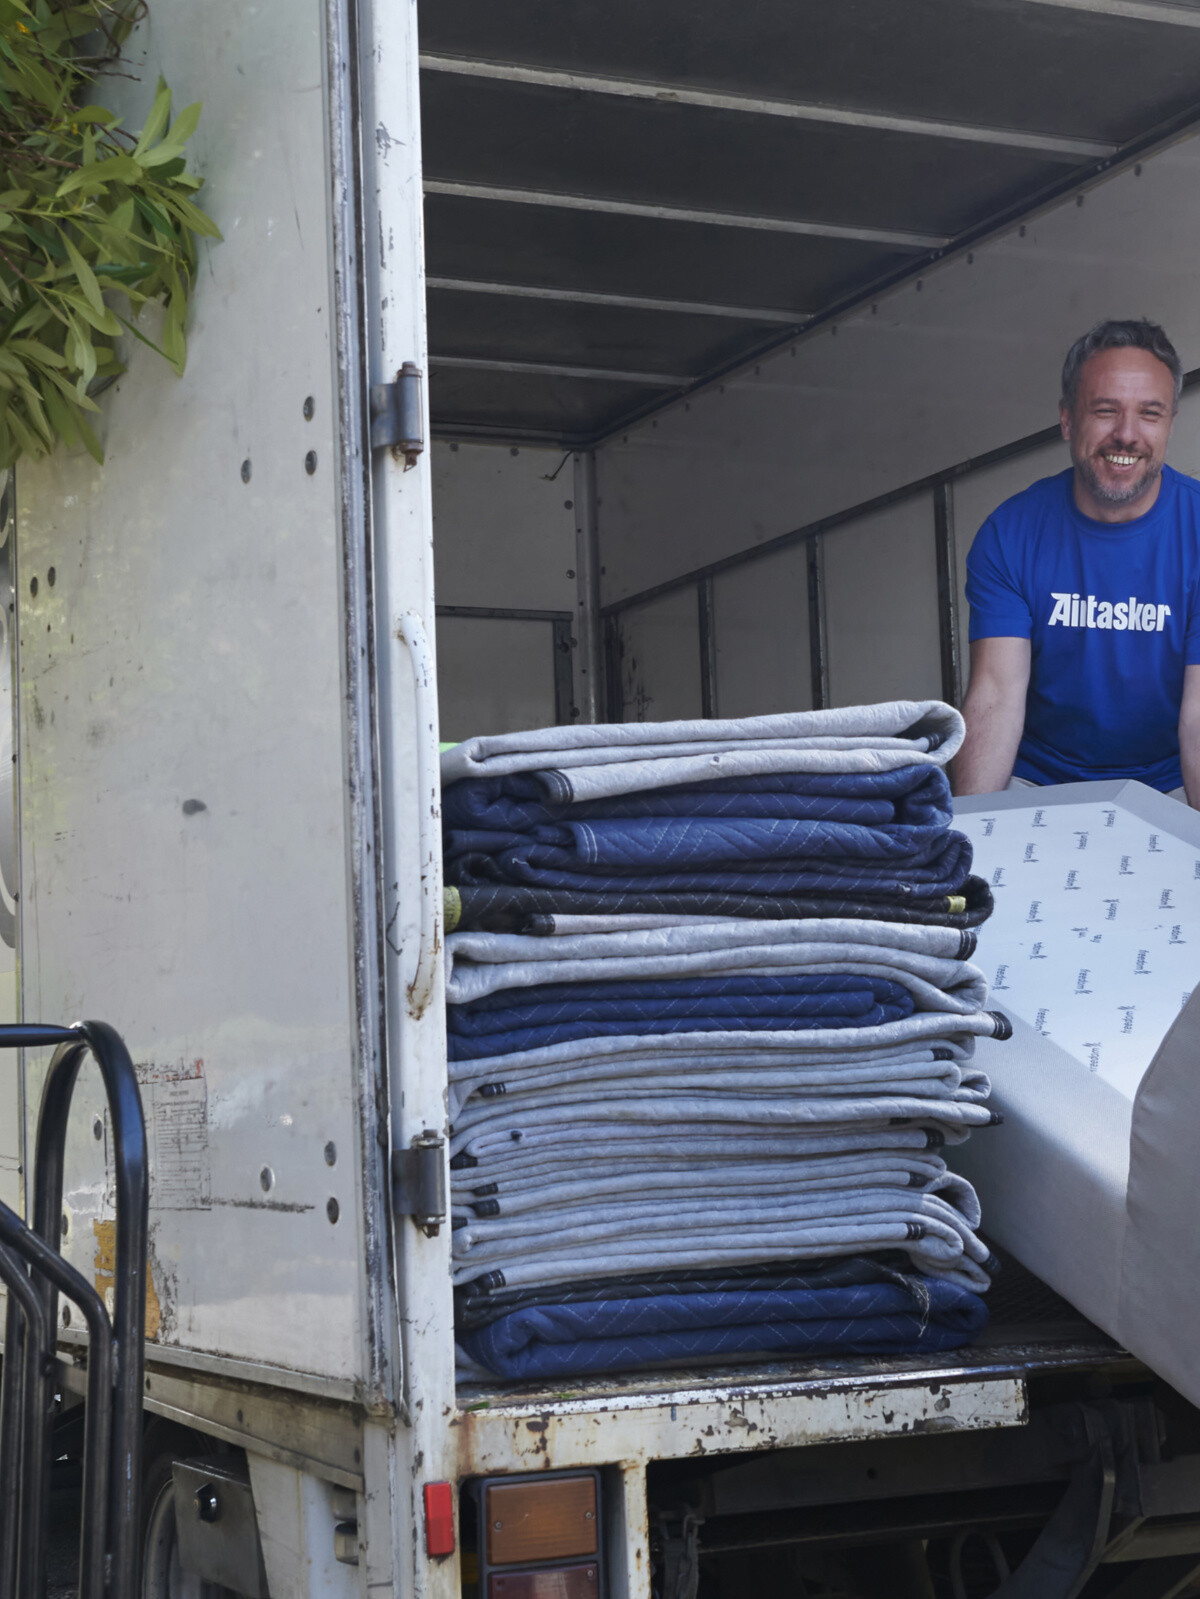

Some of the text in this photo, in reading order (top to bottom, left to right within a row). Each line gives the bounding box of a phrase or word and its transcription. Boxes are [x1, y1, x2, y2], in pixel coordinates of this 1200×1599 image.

[994, 964, 1009, 985] freedom
[1076, 968, 1091, 989] freedom
[1035, 1007, 1050, 1031] freedom
[1120, 1010, 1134, 1034] freedom
